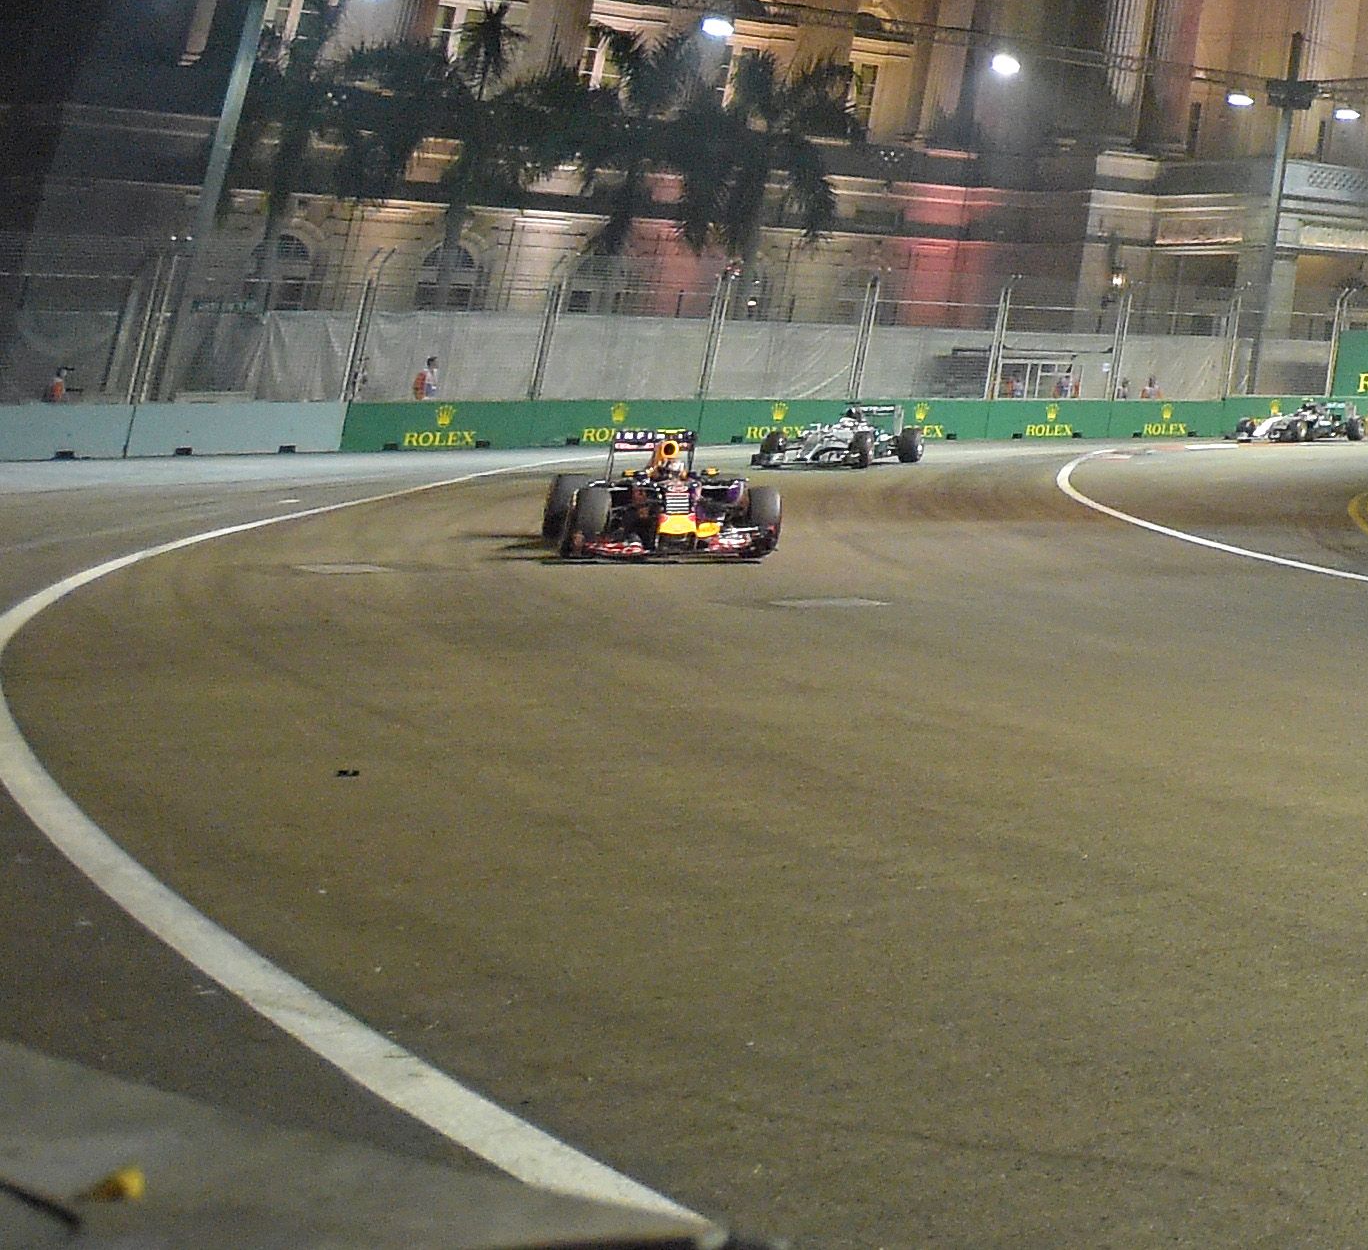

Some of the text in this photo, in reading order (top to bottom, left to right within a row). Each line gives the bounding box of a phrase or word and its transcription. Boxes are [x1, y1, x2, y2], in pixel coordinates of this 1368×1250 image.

[1025, 424, 1073, 437] ROLEX
[1143, 423, 1187, 436] ROLEX
[403, 431, 476, 447] ROLEX
